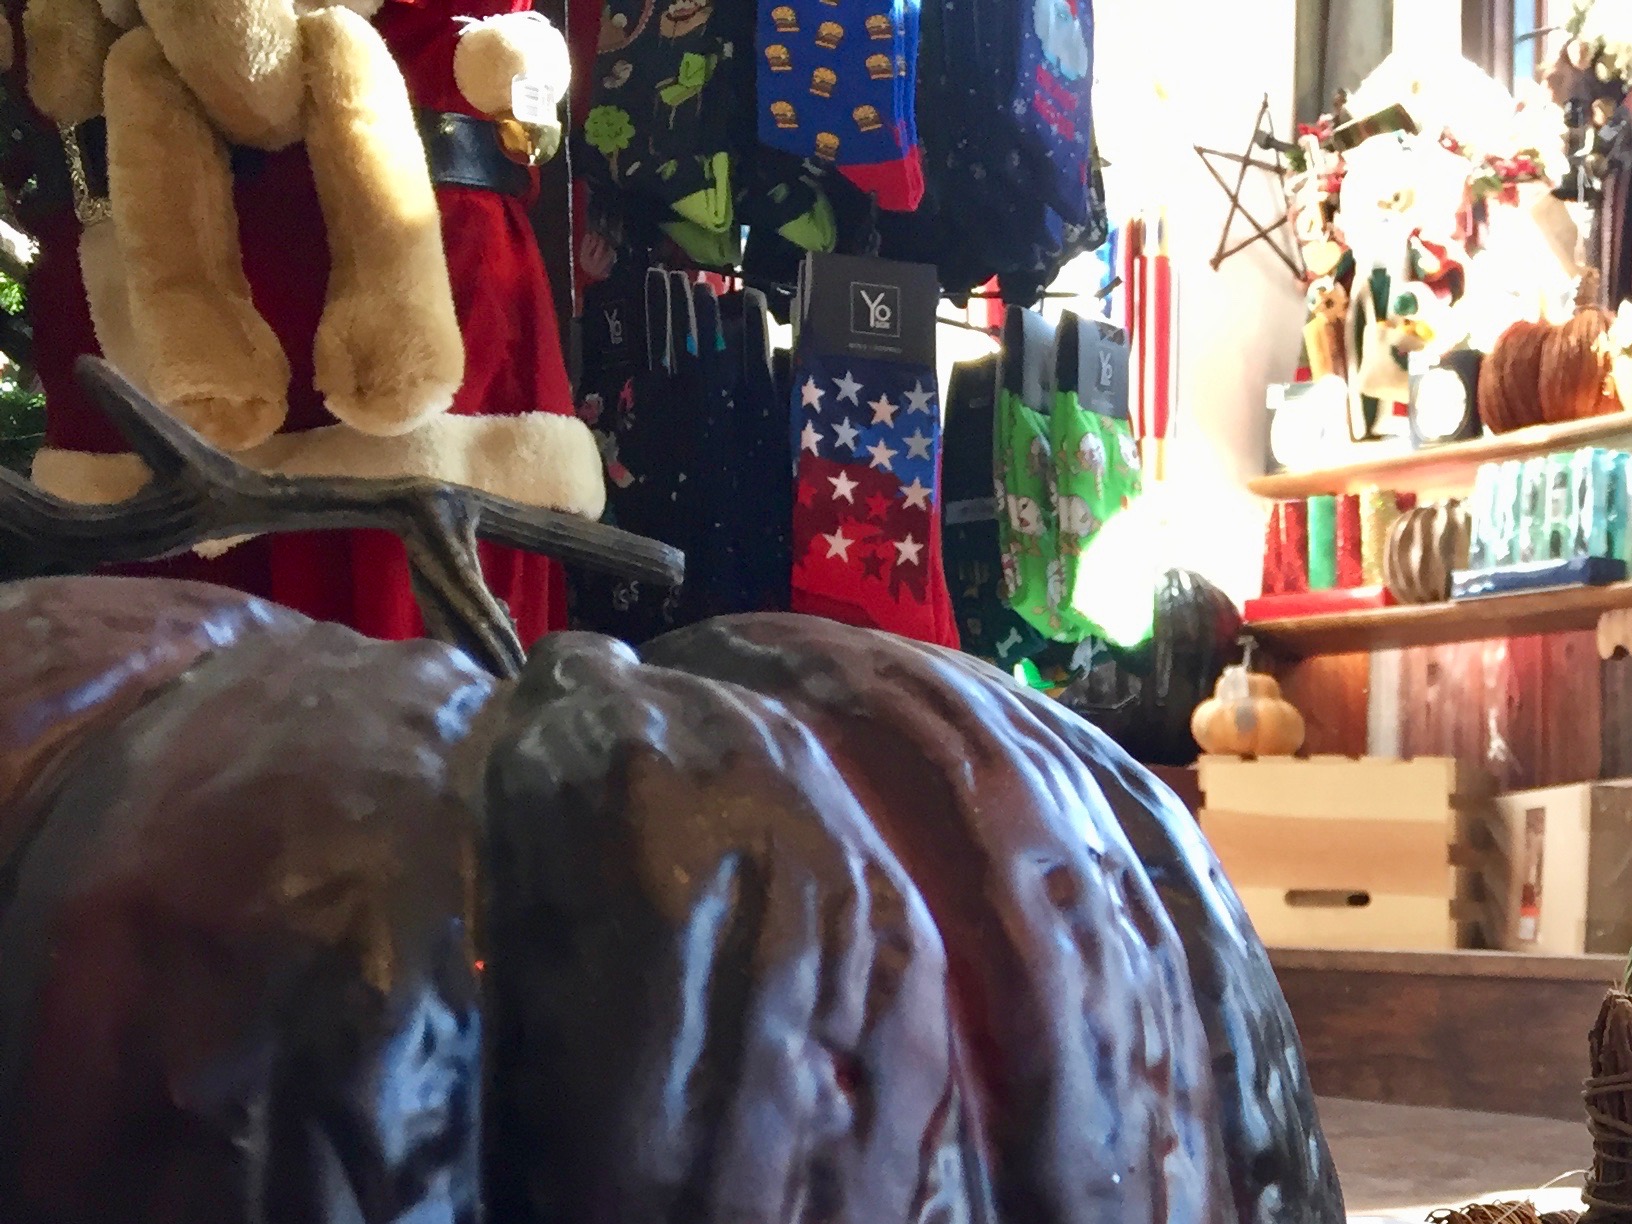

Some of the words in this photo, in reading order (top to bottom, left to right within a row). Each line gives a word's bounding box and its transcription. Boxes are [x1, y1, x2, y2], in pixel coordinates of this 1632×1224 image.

[603, 308, 622, 344] Yo
[860, 289, 892, 328] Yo
[1099, 350, 1113, 386] Yo
